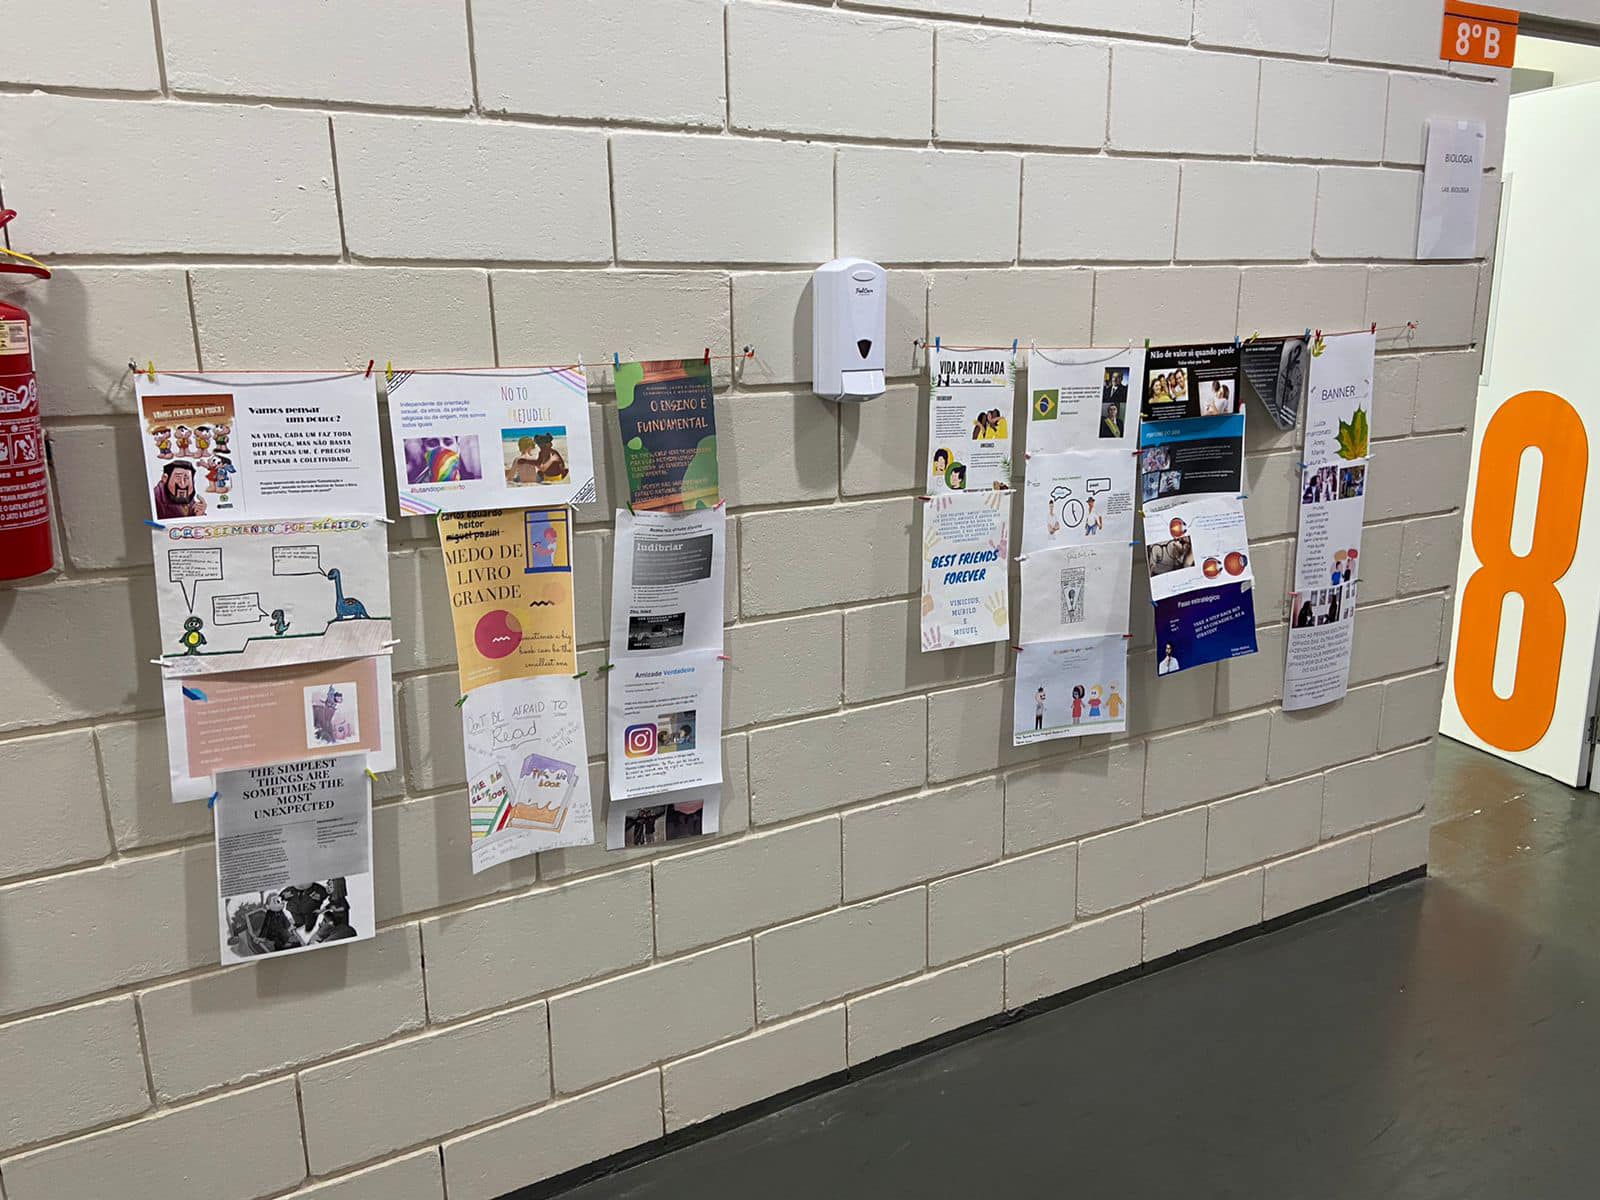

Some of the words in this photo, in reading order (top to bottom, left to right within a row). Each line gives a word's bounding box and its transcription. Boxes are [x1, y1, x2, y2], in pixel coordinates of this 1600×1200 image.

[1444, 153, 1473, 164] BIOLOGIA
[939, 360, 956, 375] VIDA
[958, 360, 1005, 375] PARTILHADA
[501, 386, 514, 401] NO
[516, 386, 528, 400] TO
[1321, 385, 1356, 401] BANNER
[650, 400, 658, 412] O
[306, 415, 341, 423] pouco?
[637, 417, 708, 433] FUNDAMENTAL
[168, 524, 276, 540] CRESCIMENTO
[458, 520, 485, 529] heitor
[445, 547, 494, 565] MEDO
[500, 544, 523, 560] DE
[931, 554, 957, 569] BEST
[958, 549, 999, 567] FRIENDS
[457, 565, 512, 585] LIVRO
[943, 568, 986, 585] FOREVER
[1453, 390, 1588, 752] 8
[453, 585, 522, 608] GRANDE
[635, 671, 662, 679] Amizade
[663, 667, 695, 676] Verdadeira
[511, 701, 545, 717] AFRAID
[552, 700, 568, 711] TO
[492, 720, 537, 747] Read
[248, 768, 275, 779] THE
[277, 759, 337, 774] SIMPLEST
[256, 775, 304, 787] THINGS
[306, 769, 331, 780] ARE
[242, 783, 316, 800] SOMETIMES
[318, 778, 345, 789] THE
[276, 792, 313, 806] MOST
[253, 800, 335, 820] UNEXPECTED
